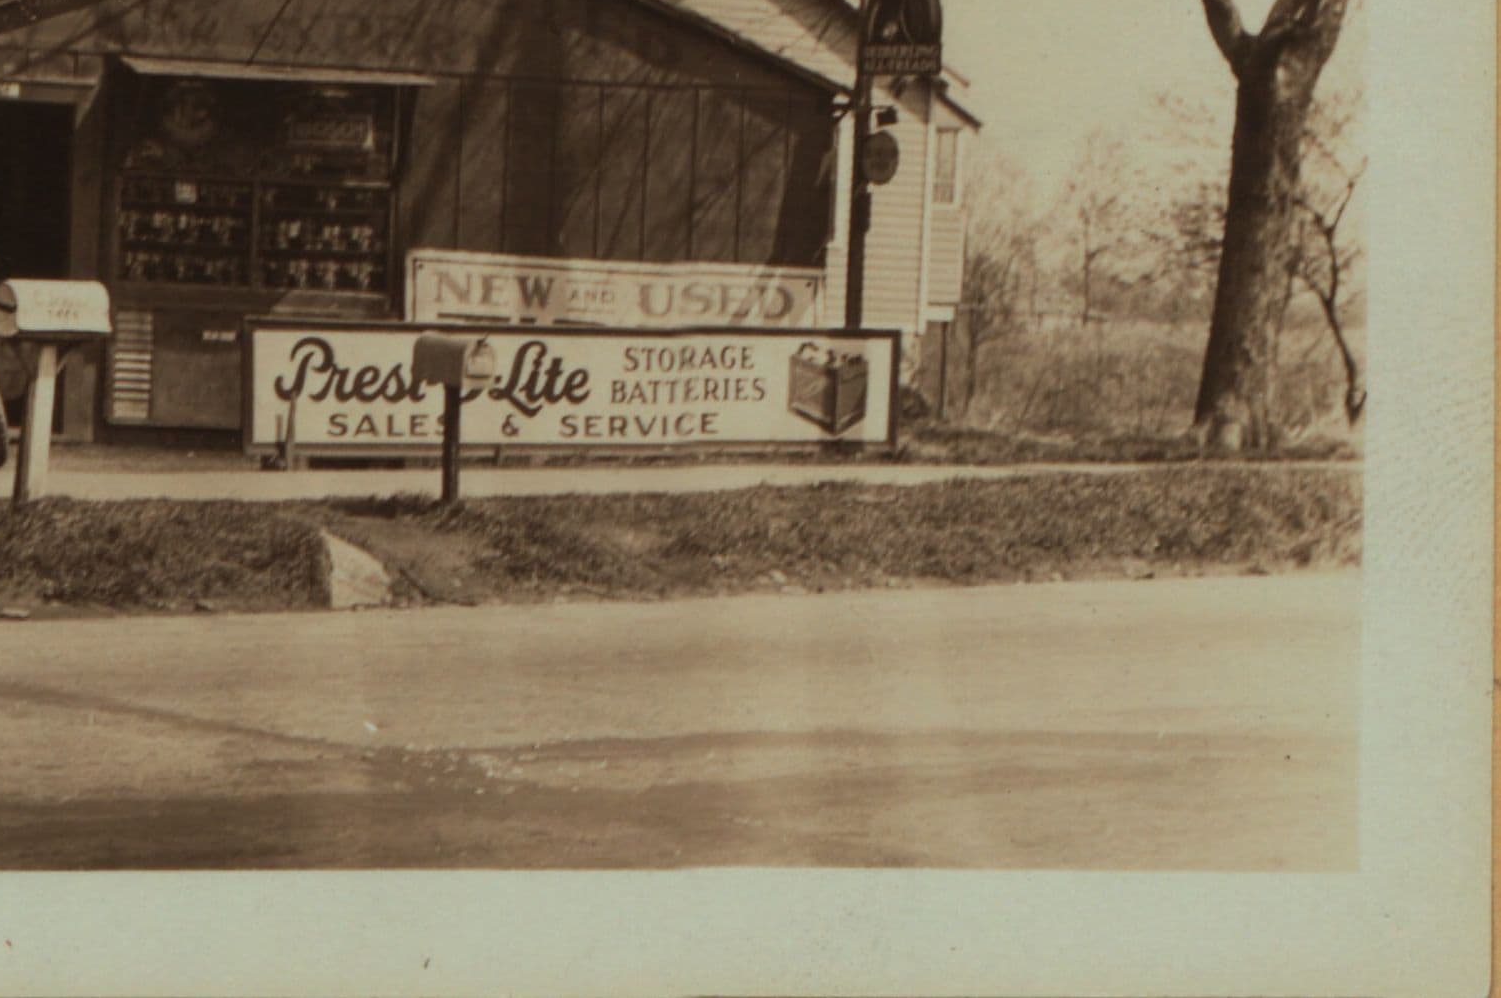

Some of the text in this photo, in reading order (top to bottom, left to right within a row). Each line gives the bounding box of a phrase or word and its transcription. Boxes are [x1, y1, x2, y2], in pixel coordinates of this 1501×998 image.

[435, 271, 795, 320] NEW AND USED
[623, 345, 755, 373] STORAGE
[610, 377, 767, 404] BATTERIES
[501, 413, 519, 438] &
[559, 412, 720, 439] SERVICE
